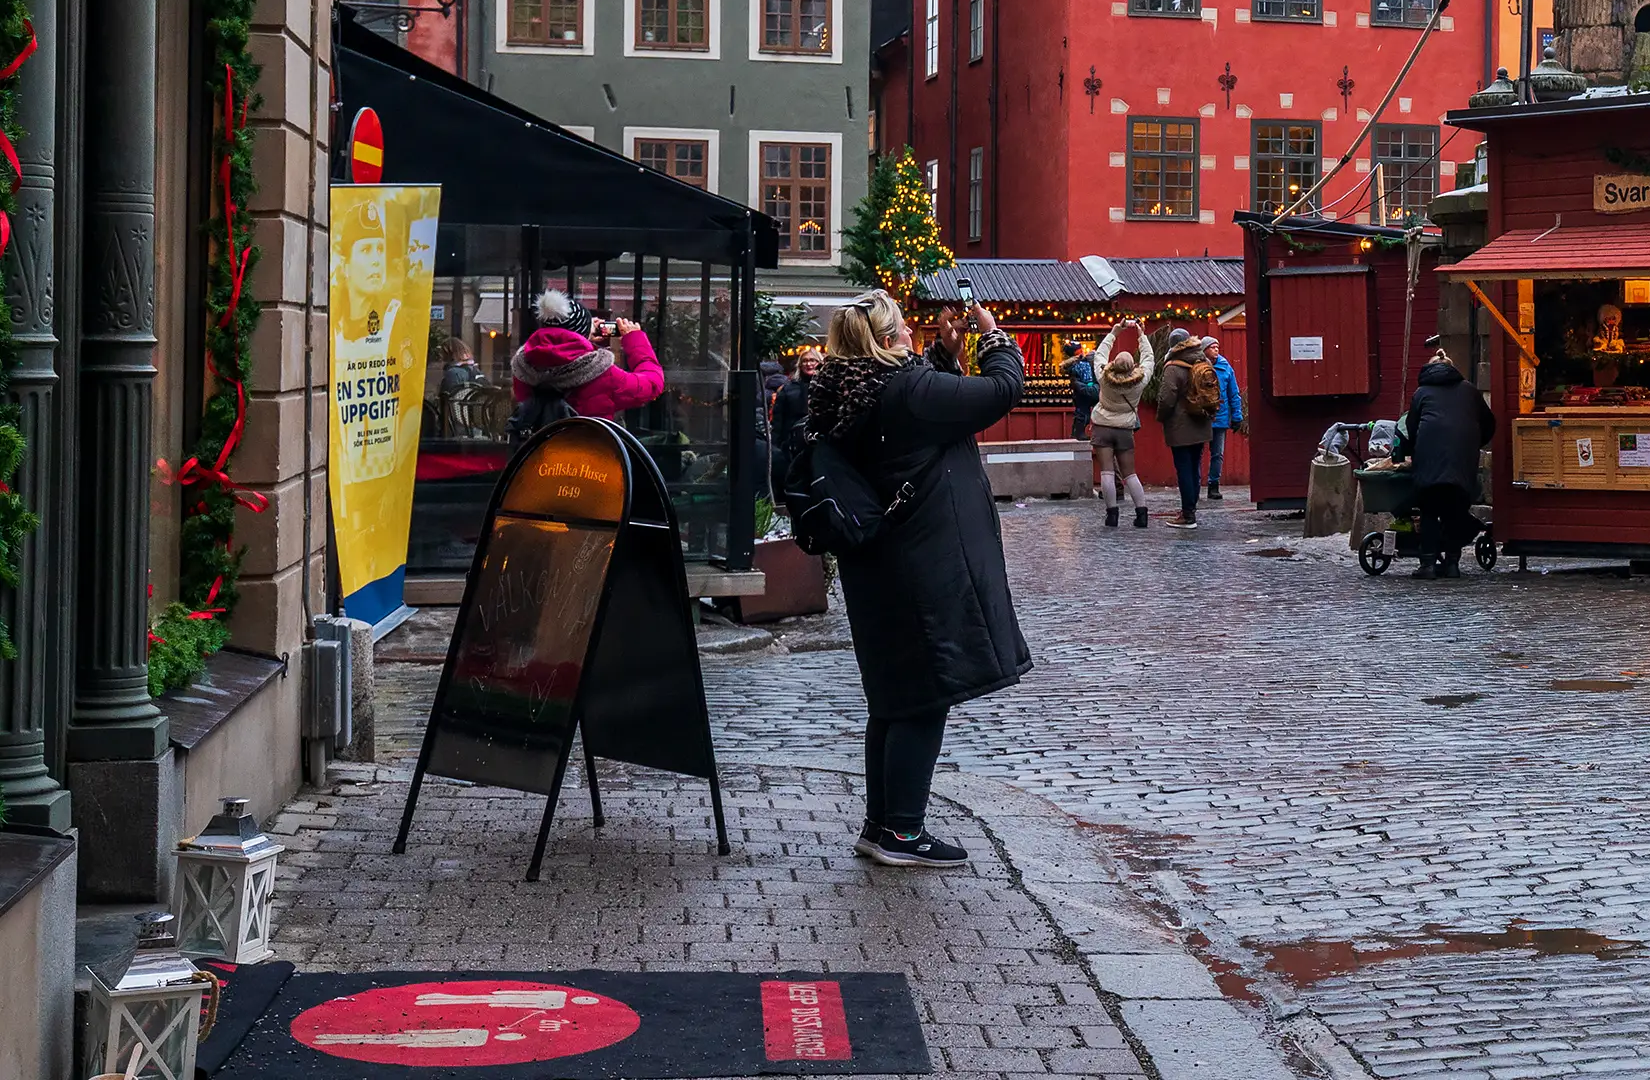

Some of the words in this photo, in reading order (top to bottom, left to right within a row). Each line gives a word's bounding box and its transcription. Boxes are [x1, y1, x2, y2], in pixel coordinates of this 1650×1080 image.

[357, 361, 367, 370] DU
[369, 359, 386, 369] REDO
[387, 356, 397, 367] FÖR
[337, 380, 352, 401] EN
[341, 396, 400, 424] UPPGIFT?
[538, 463, 578, 478] Grillska
[579, 464, 609, 484] Huset
[557, 485, 581, 499] 1649
